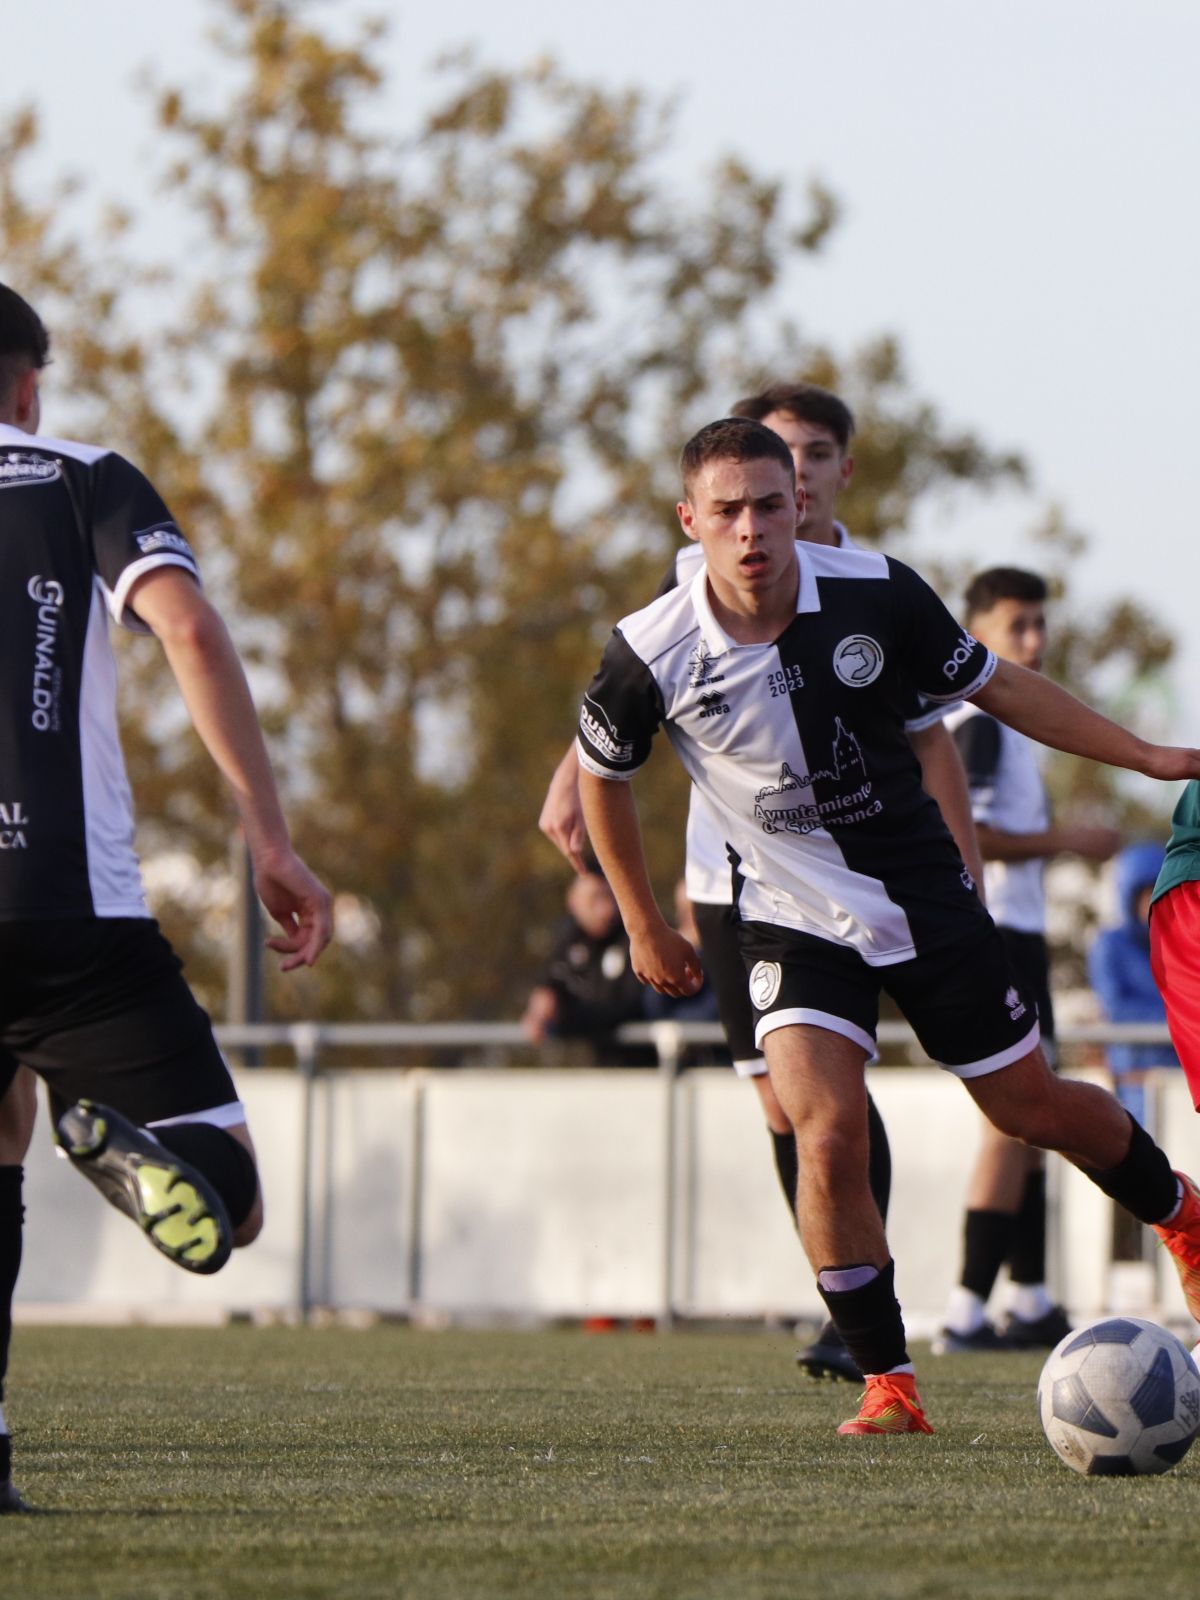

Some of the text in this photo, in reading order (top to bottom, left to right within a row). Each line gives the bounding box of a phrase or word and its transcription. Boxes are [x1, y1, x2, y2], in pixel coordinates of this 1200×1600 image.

[27, 574, 64, 732] GUINALDO
[768, 664, 801, 686] 2013
[770, 676, 804, 698] 2023
[754, 781, 872, 824] Ayuntamiento
